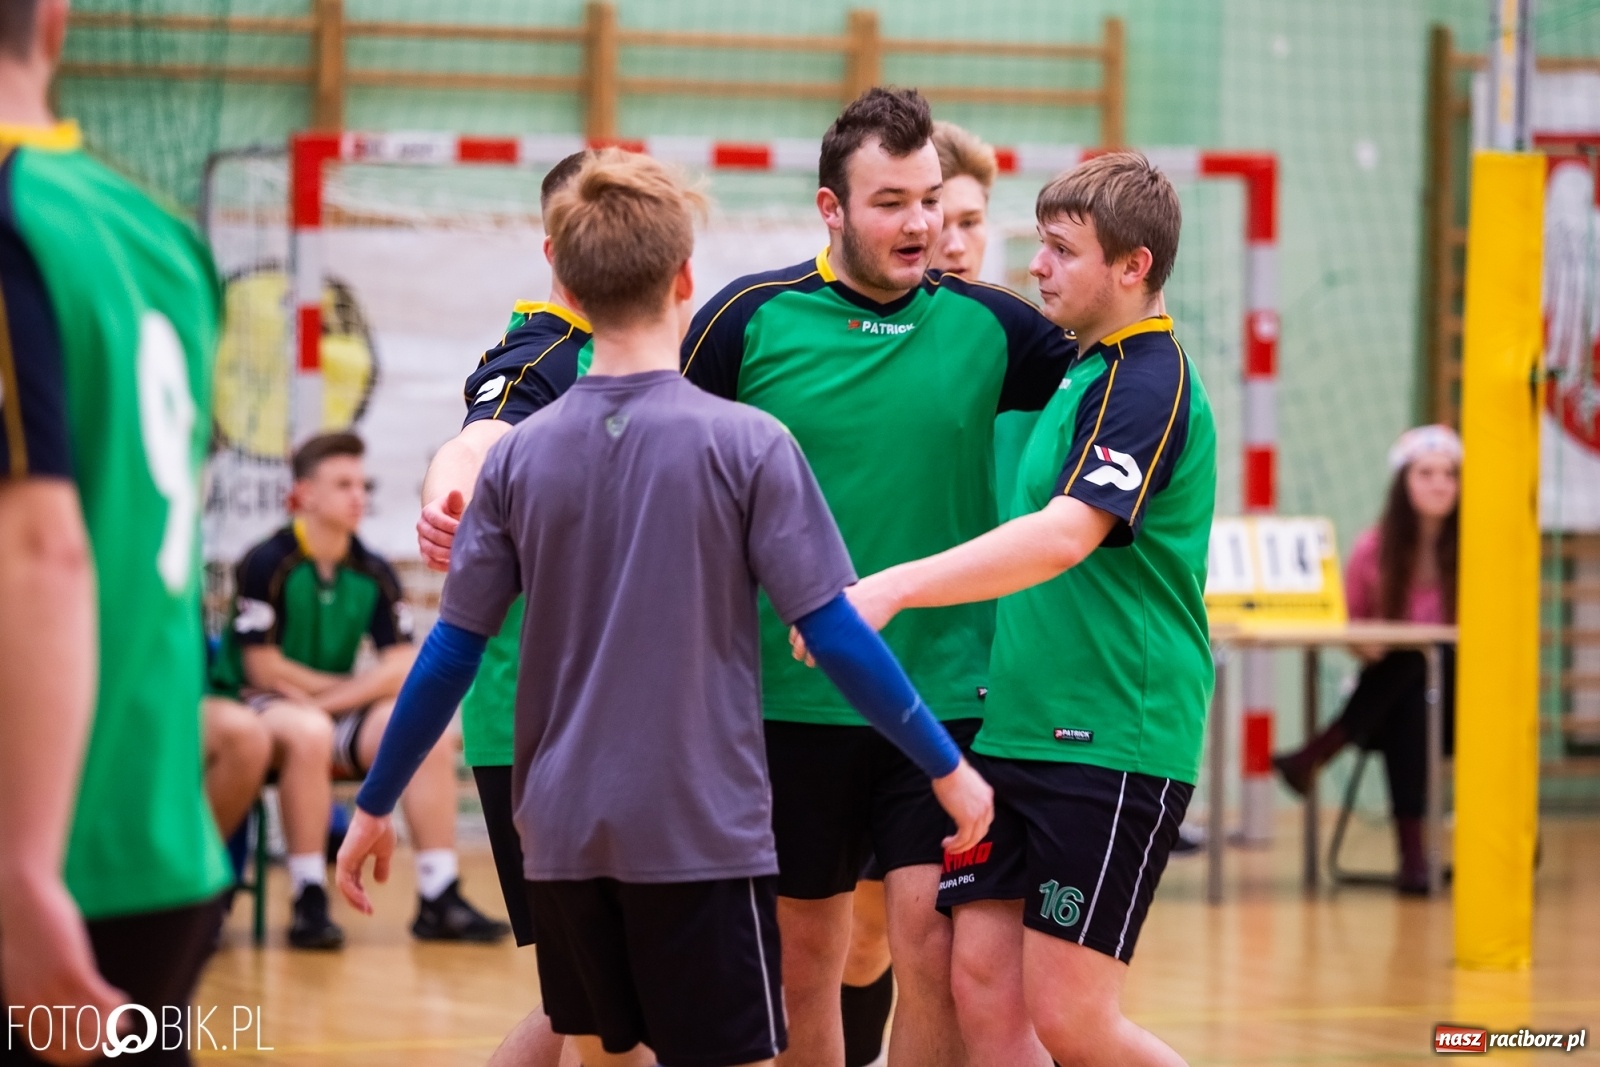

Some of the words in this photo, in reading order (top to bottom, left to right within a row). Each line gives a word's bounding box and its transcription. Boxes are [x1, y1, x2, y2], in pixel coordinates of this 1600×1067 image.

[938, 878, 957, 890] RUPA
[958, 873, 975, 885] PBG
[1039, 878, 1085, 927] 16
